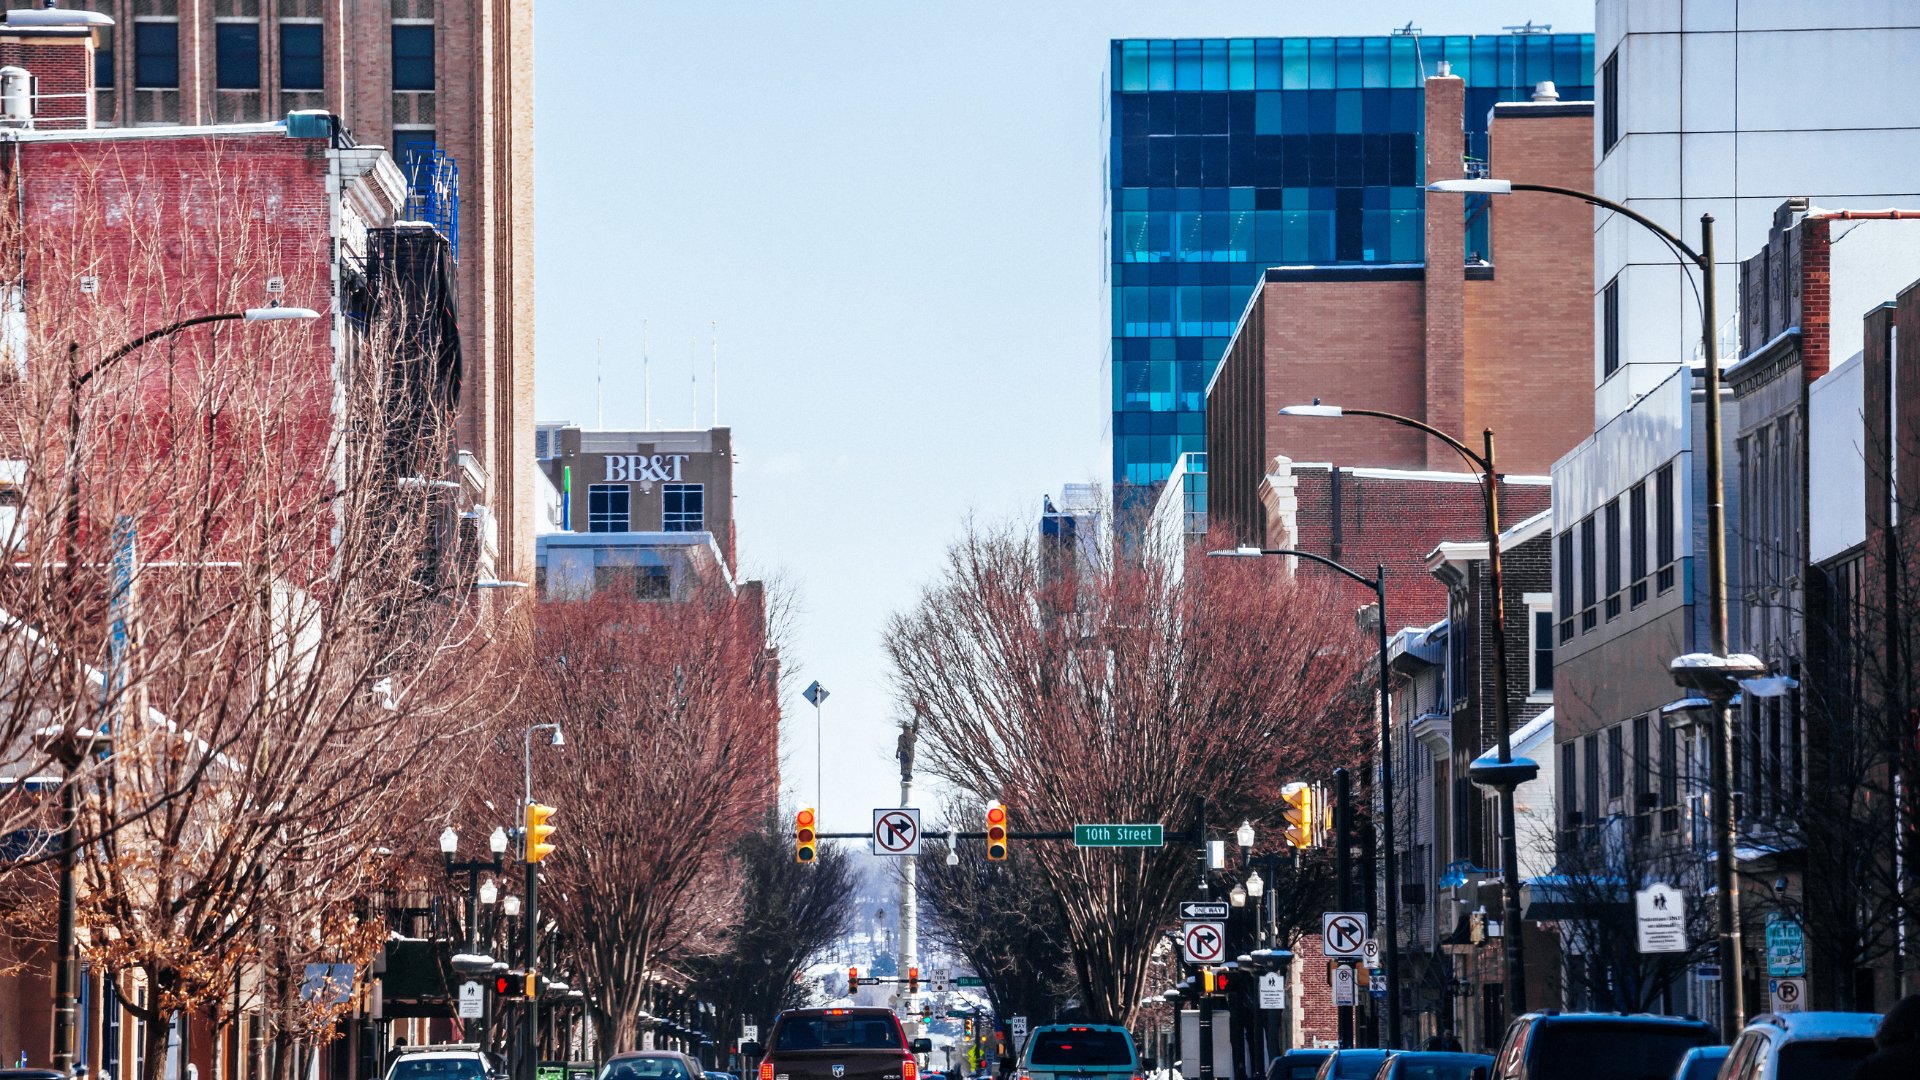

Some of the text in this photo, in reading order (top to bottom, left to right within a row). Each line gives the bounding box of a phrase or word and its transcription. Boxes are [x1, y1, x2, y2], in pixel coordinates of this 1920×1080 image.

[603, 454, 689, 482] BB&T
[1086, 827, 1152, 841] 10th Street
[1769, 926, 1800, 938] METER
